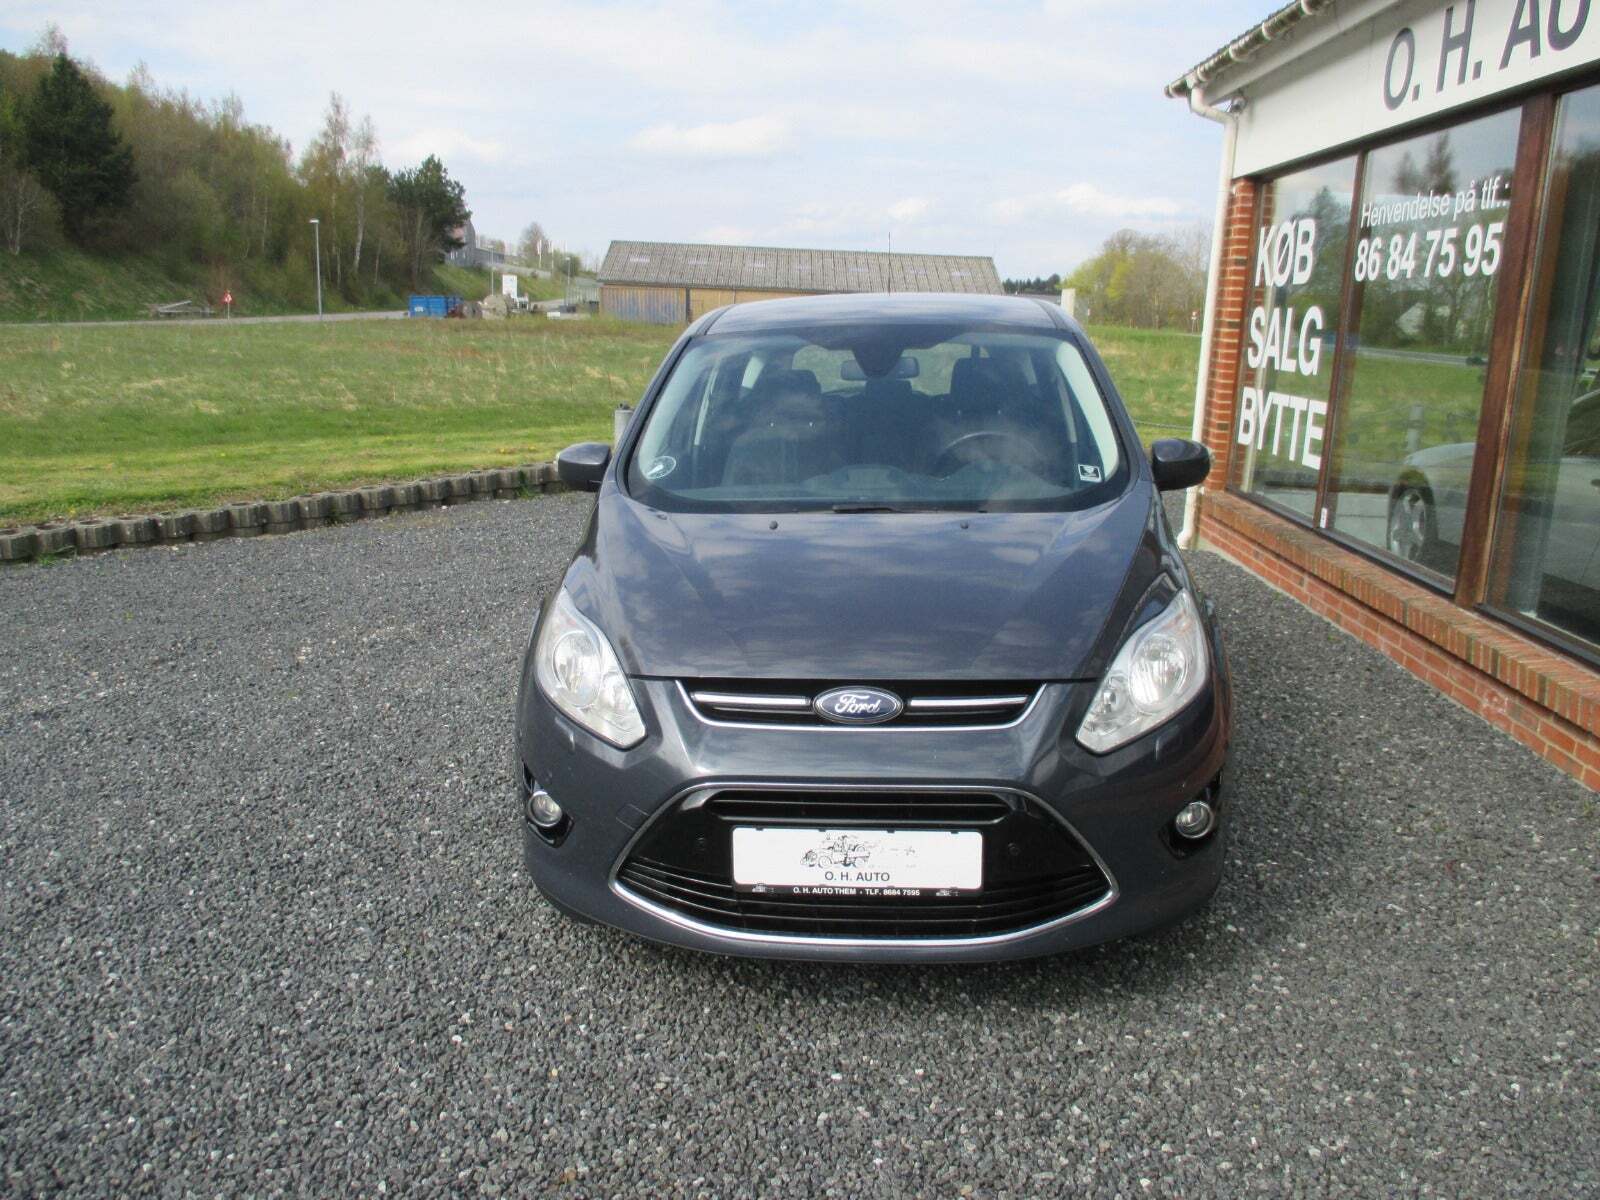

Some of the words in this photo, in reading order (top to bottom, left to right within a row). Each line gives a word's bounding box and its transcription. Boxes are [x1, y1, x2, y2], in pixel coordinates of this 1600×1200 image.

[1384, 27, 1421, 111] O.
[1436, 0, 1483, 94] H.
[1360, 189, 1450, 229] Henvendelse
[1453, 179, 1477, 222] på
[1254, 218, 1317, 288] KØB
[1354, 236, 1382, 282] 86
[1386, 231, 1418, 281] 84
[1424, 227, 1458, 278] 75
[1463, 221, 1504, 277] 95
[1247, 305, 1324, 377] SALG
[1237, 385, 1329, 471] BYTTE
[834, 693, 882, 714] Ford
[793, 886, 802, 895] O.
[803, 887, 812, 895] H.
[812, 887, 834, 895] AUTO
[834, 887, 857, 896] THEM
[824, 871, 837, 881] O.
[840, 871, 853, 881] H.
[855, 872, 891, 882] AUTO
